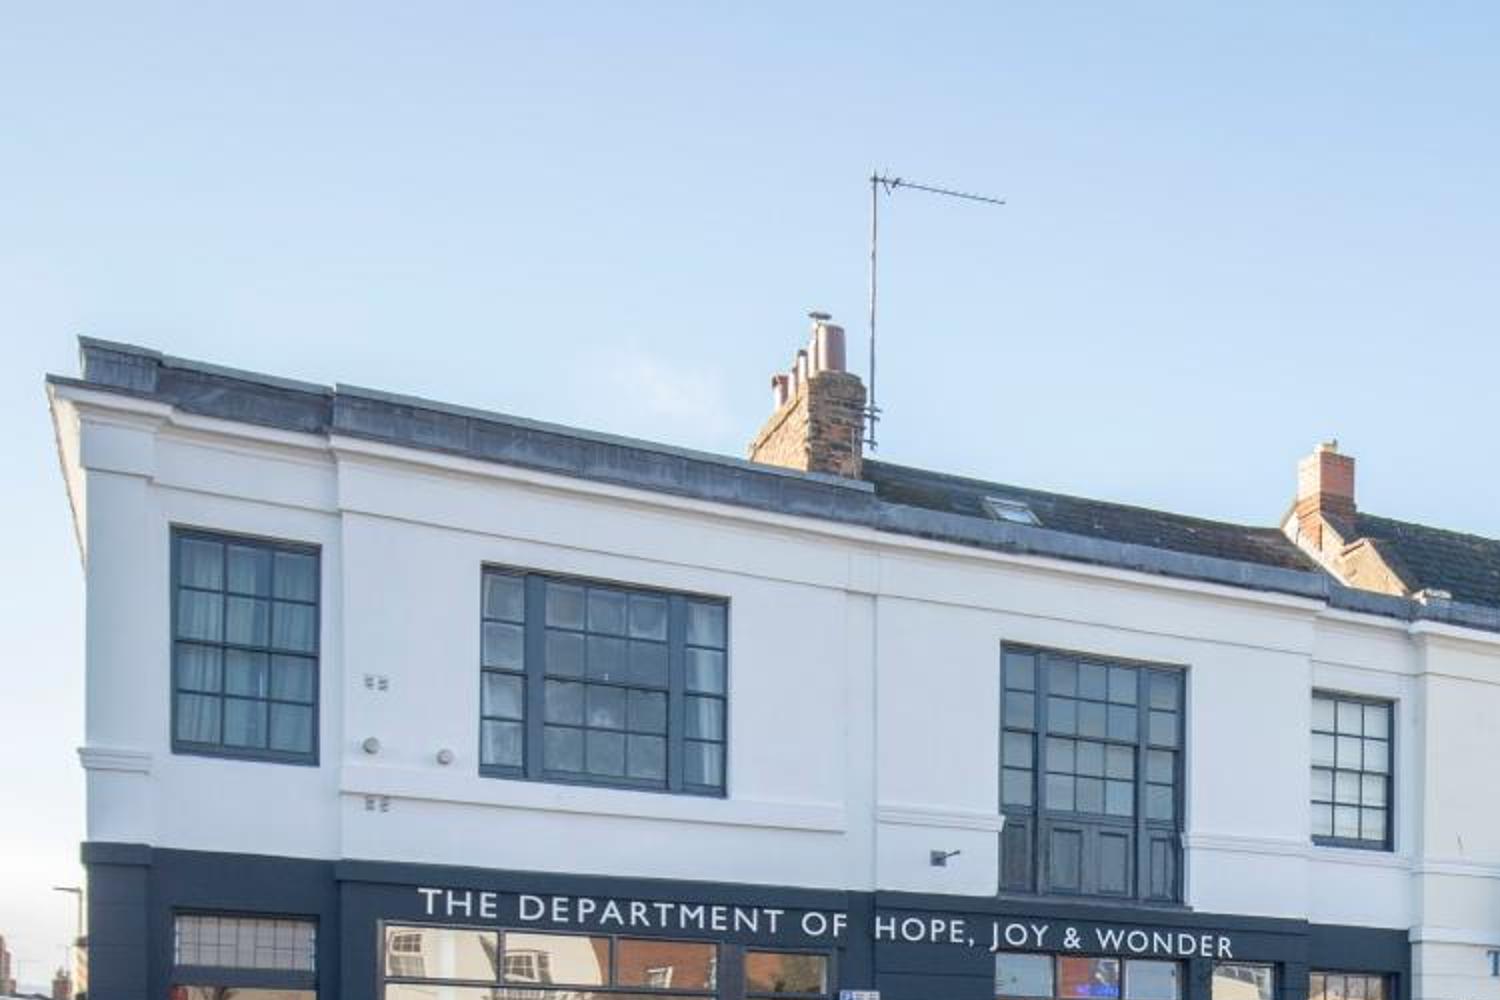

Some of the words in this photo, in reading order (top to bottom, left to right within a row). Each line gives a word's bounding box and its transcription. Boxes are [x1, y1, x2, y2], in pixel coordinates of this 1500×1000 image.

[418, 887, 498, 919] THE
[518, 894, 785, 934] DEPARTMENT
[801, 910, 848, 938] OF
[874, 916, 976, 947] HOPE,
[989, 922, 1049, 953] JOY
[1063, 927, 1082, 949] &
[1096, 928, 1234, 959] WONDER
